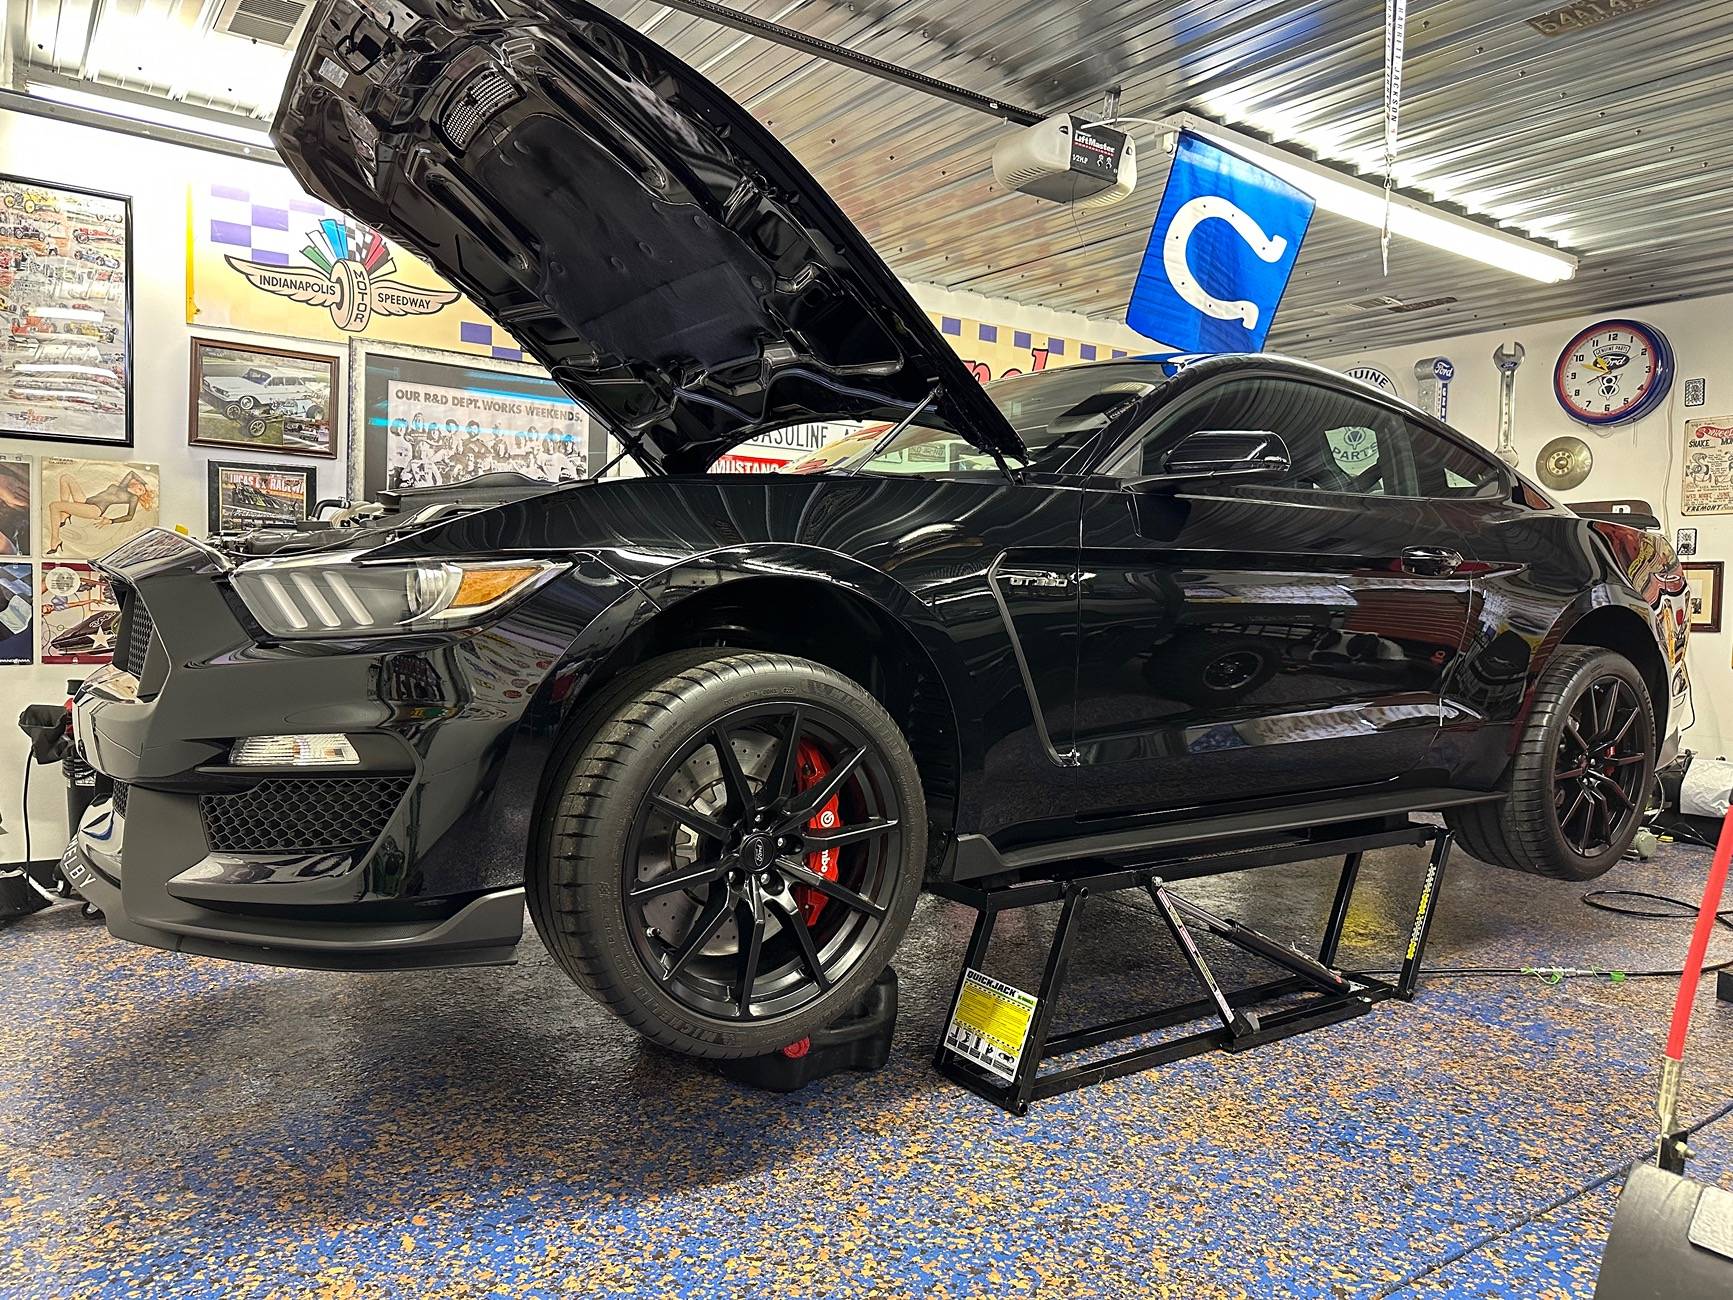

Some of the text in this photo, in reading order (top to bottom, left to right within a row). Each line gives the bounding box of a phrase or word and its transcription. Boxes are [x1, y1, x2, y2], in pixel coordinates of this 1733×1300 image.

[1391, 66, 1400, 122] JACKSON
[1074, 133, 1115, 153] LiftMaster
[259, 269, 431, 323] INDIANAPOLIS MOTOR SPEEDWAY
[1608, 333, 1618, 341] 12
[1630, 335, 1634, 343] 1
[1641, 348, 1647, 356] 2
[1433, 361, 1453, 377] Ford
[1645, 366, 1651, 374] 3
[1637, 384, 1644, 392] 4
[395, 388, 583, 423] OUR R&D DEPT. WORKS WEEKENDS.
[1585, 400, 1591, 408] 7
[1604, 404, 1610, 412] 6
[1688, 439, 1710, 448] SNAKE
[1332, 442, 1377, 461] PARTS
[230, 473, 253, 486] LUCAS
[966, 970, 1017, 998] QUICKJACK
